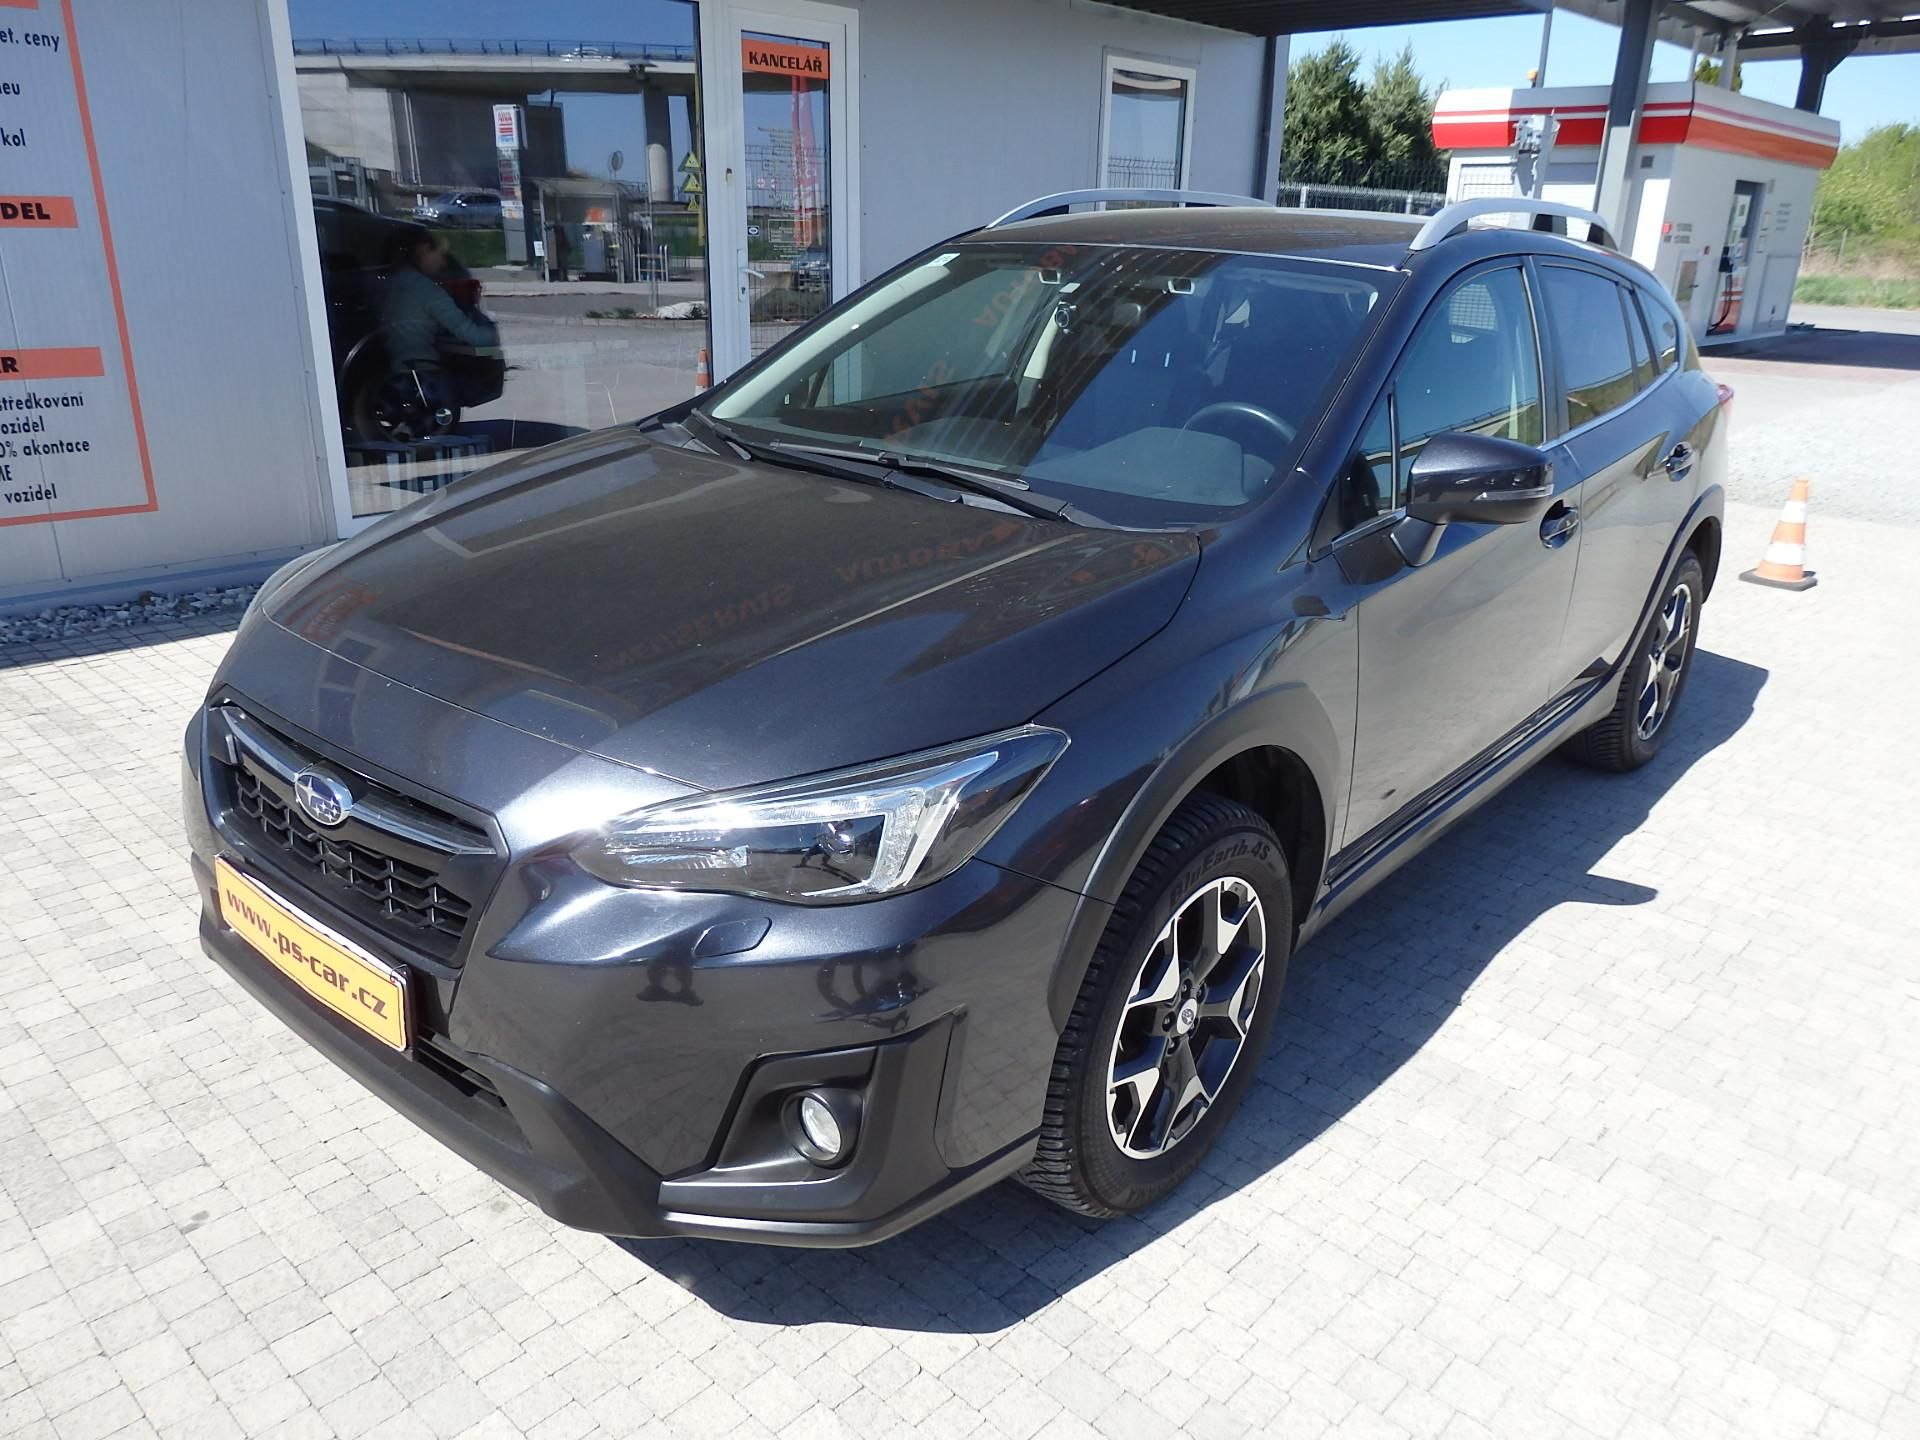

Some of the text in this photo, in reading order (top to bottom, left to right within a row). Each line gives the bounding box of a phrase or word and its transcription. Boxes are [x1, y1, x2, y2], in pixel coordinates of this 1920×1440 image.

[24, 32, 60, 53] ceny
[748, 51, 822, 72] KANCELÁŘ
[0, 82, 20, 96] eu
[0, 127, 26, 147] kol
[23, 438, 90, 456] akontace
[4, 483, 57, 503] vozidel
[226, 888, 388, 1020] www.ps-car.cz
